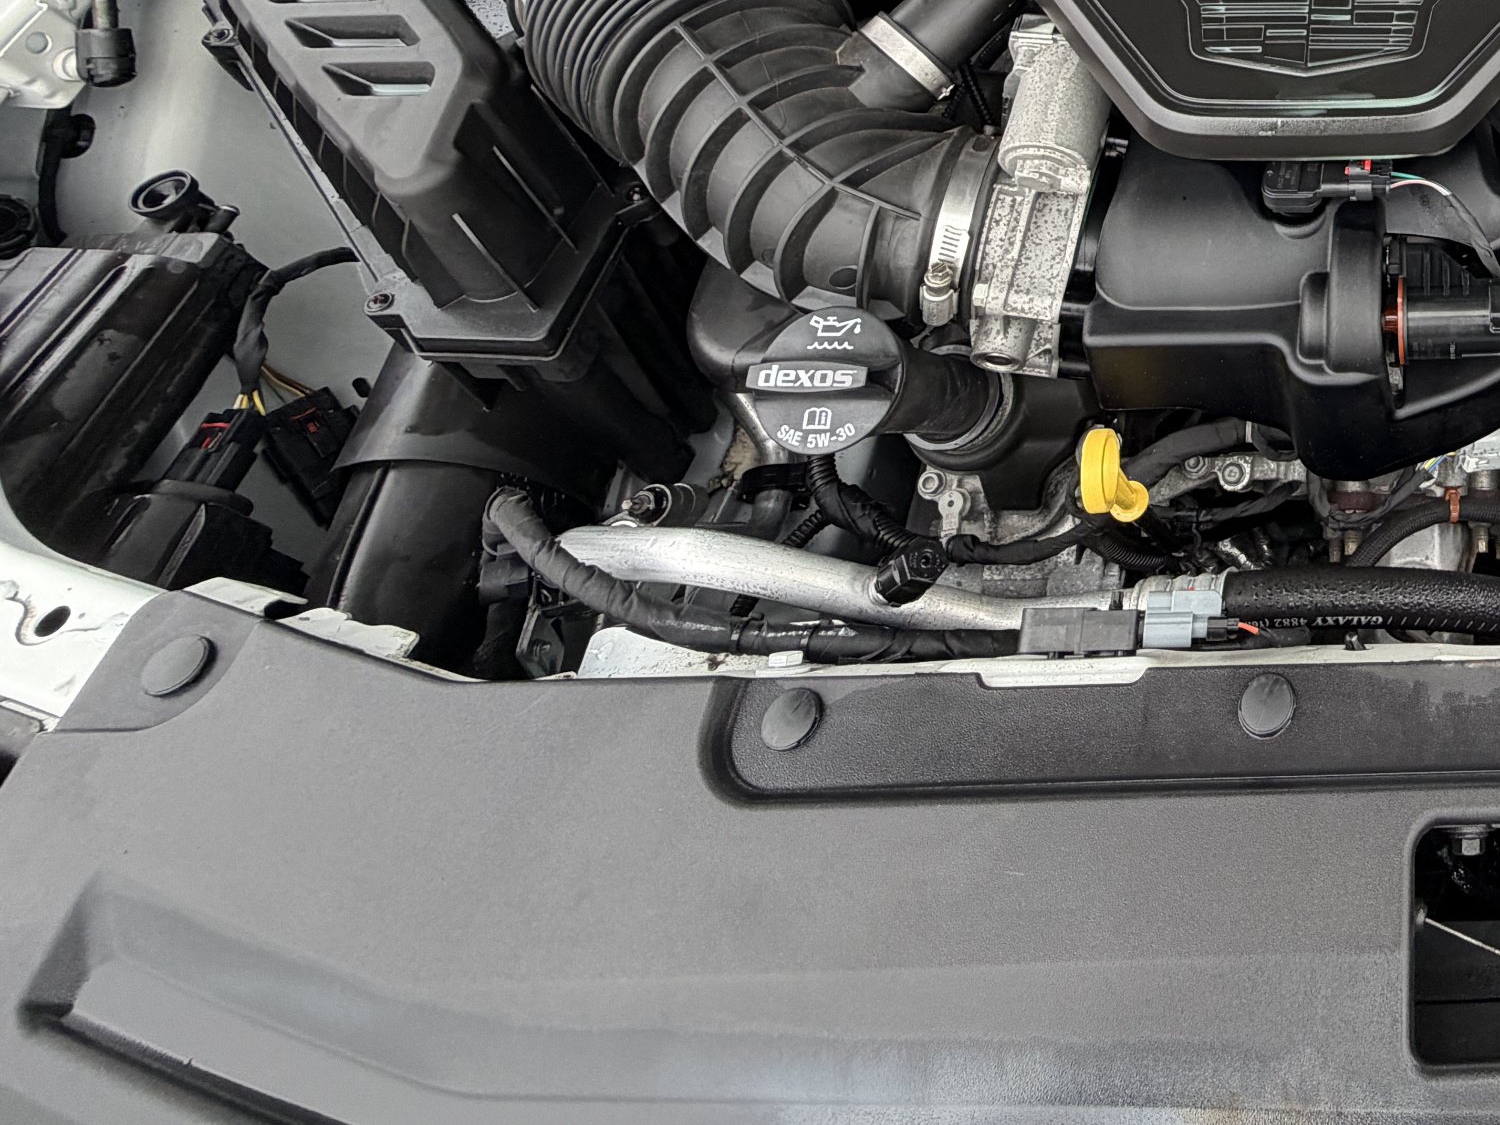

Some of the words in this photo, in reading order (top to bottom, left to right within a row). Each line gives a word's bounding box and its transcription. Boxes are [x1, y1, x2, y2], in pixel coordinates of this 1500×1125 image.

[757, 364, 854, 388] dexos
[777, 425, 802, 446] SAE
[806, 423, 856, 449] 5W-30
[1273, 618, 1308, 628] 4882
[1314, 616, 1384, 626] GALAXY
